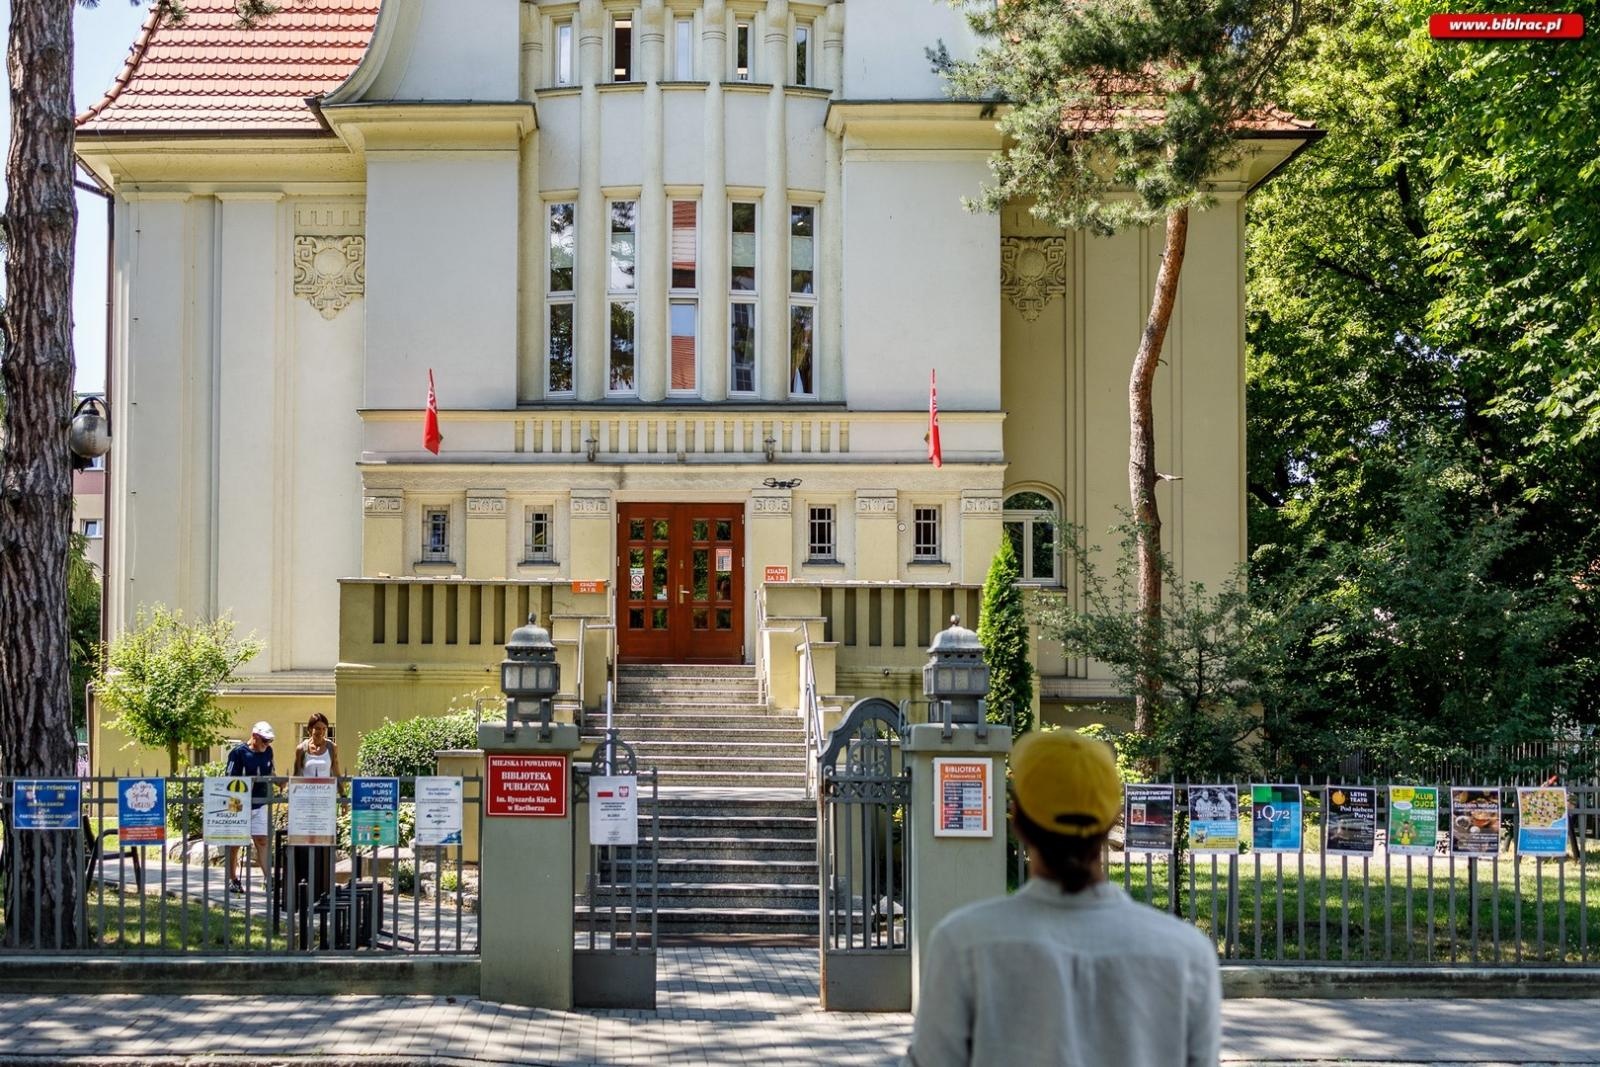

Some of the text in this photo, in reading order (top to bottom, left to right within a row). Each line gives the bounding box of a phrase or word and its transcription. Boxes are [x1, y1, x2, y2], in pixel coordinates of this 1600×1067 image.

[501, 771, 552, 780] BIBLIOTEKA
[503, 783, 550, 791] PUBLICZNA
[508, 796, 535, 804] Ryszarda
[1256, 805, 1290, 822] 1Q72
